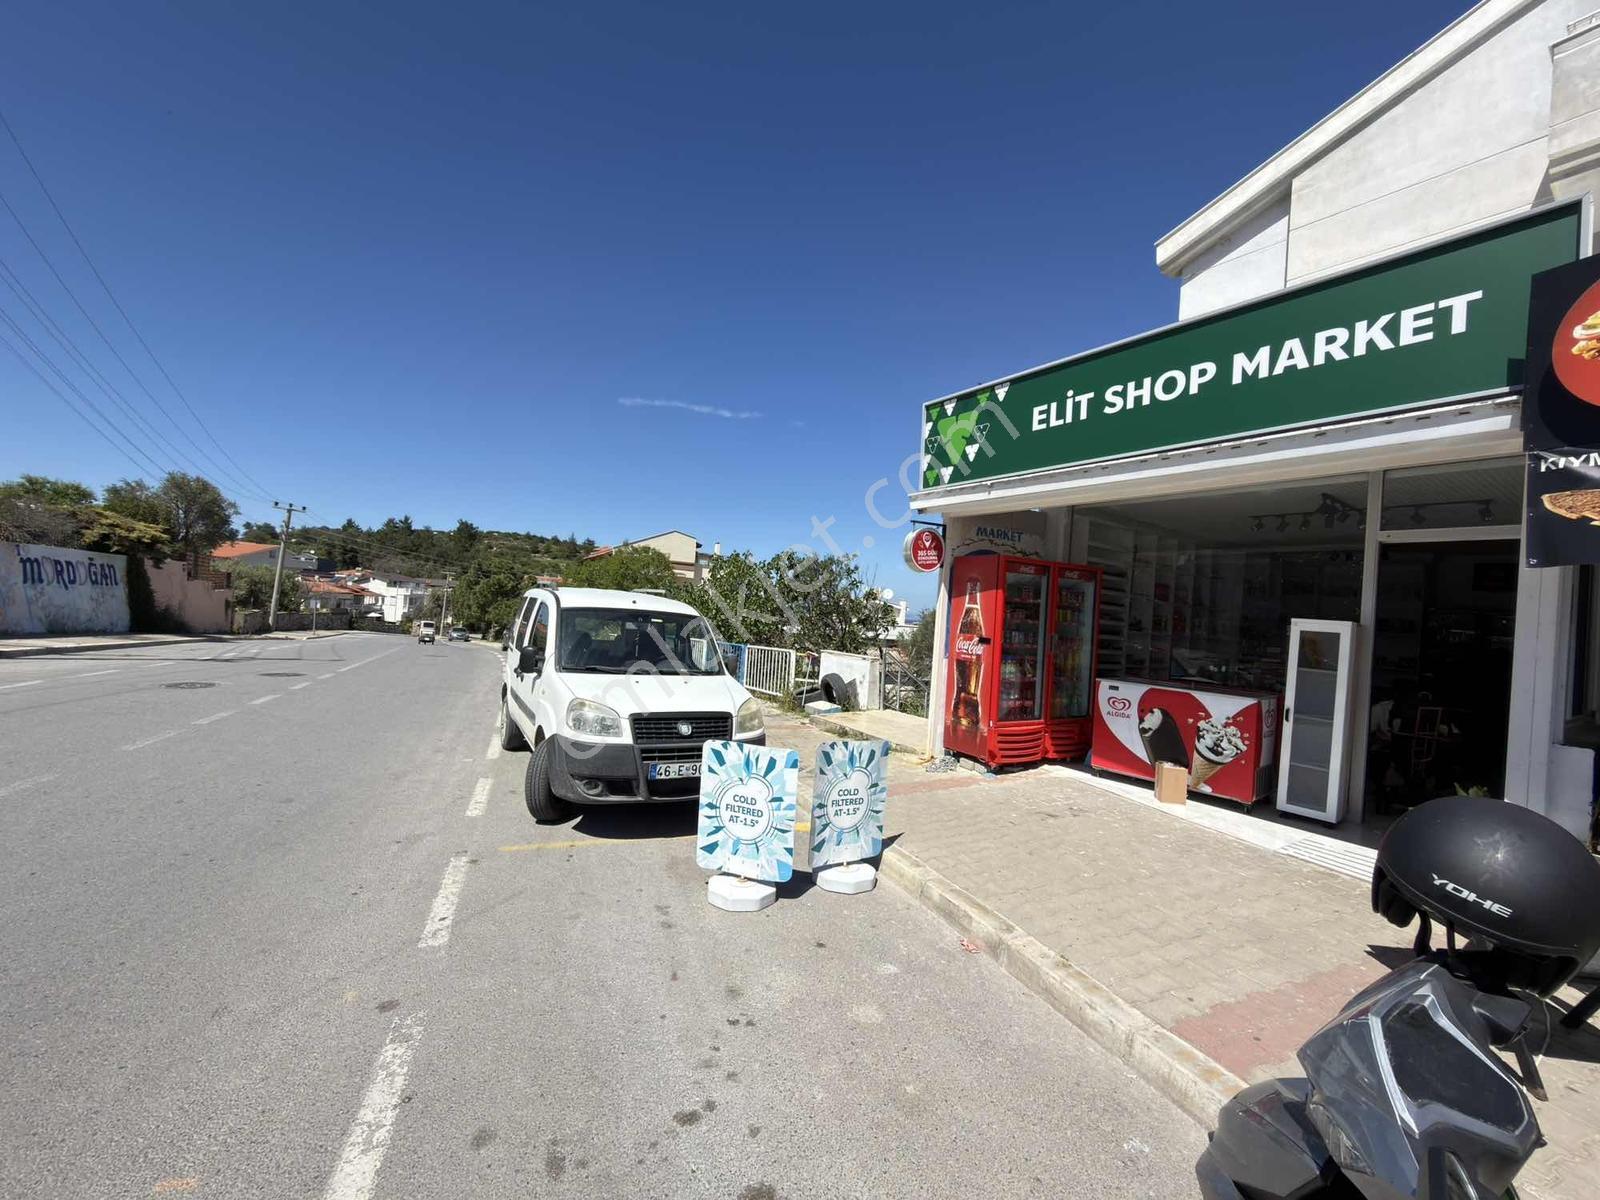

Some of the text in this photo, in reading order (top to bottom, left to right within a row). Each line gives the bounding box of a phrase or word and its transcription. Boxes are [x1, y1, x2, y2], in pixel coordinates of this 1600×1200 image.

[1032, 289, 1483, 431] ELİT SHOP MARKET
[976, 526, 1025, 542] MARKET
[657, 764, 671, 777] 46
[837, 788, 859, 797] COLD
[732, 794, 757, 806] COLD
[831, 797, 864, 808] FILTERED
[725, 803, 763, 818] FILTERED
[1431, 872, 1513, 918] YOHE
